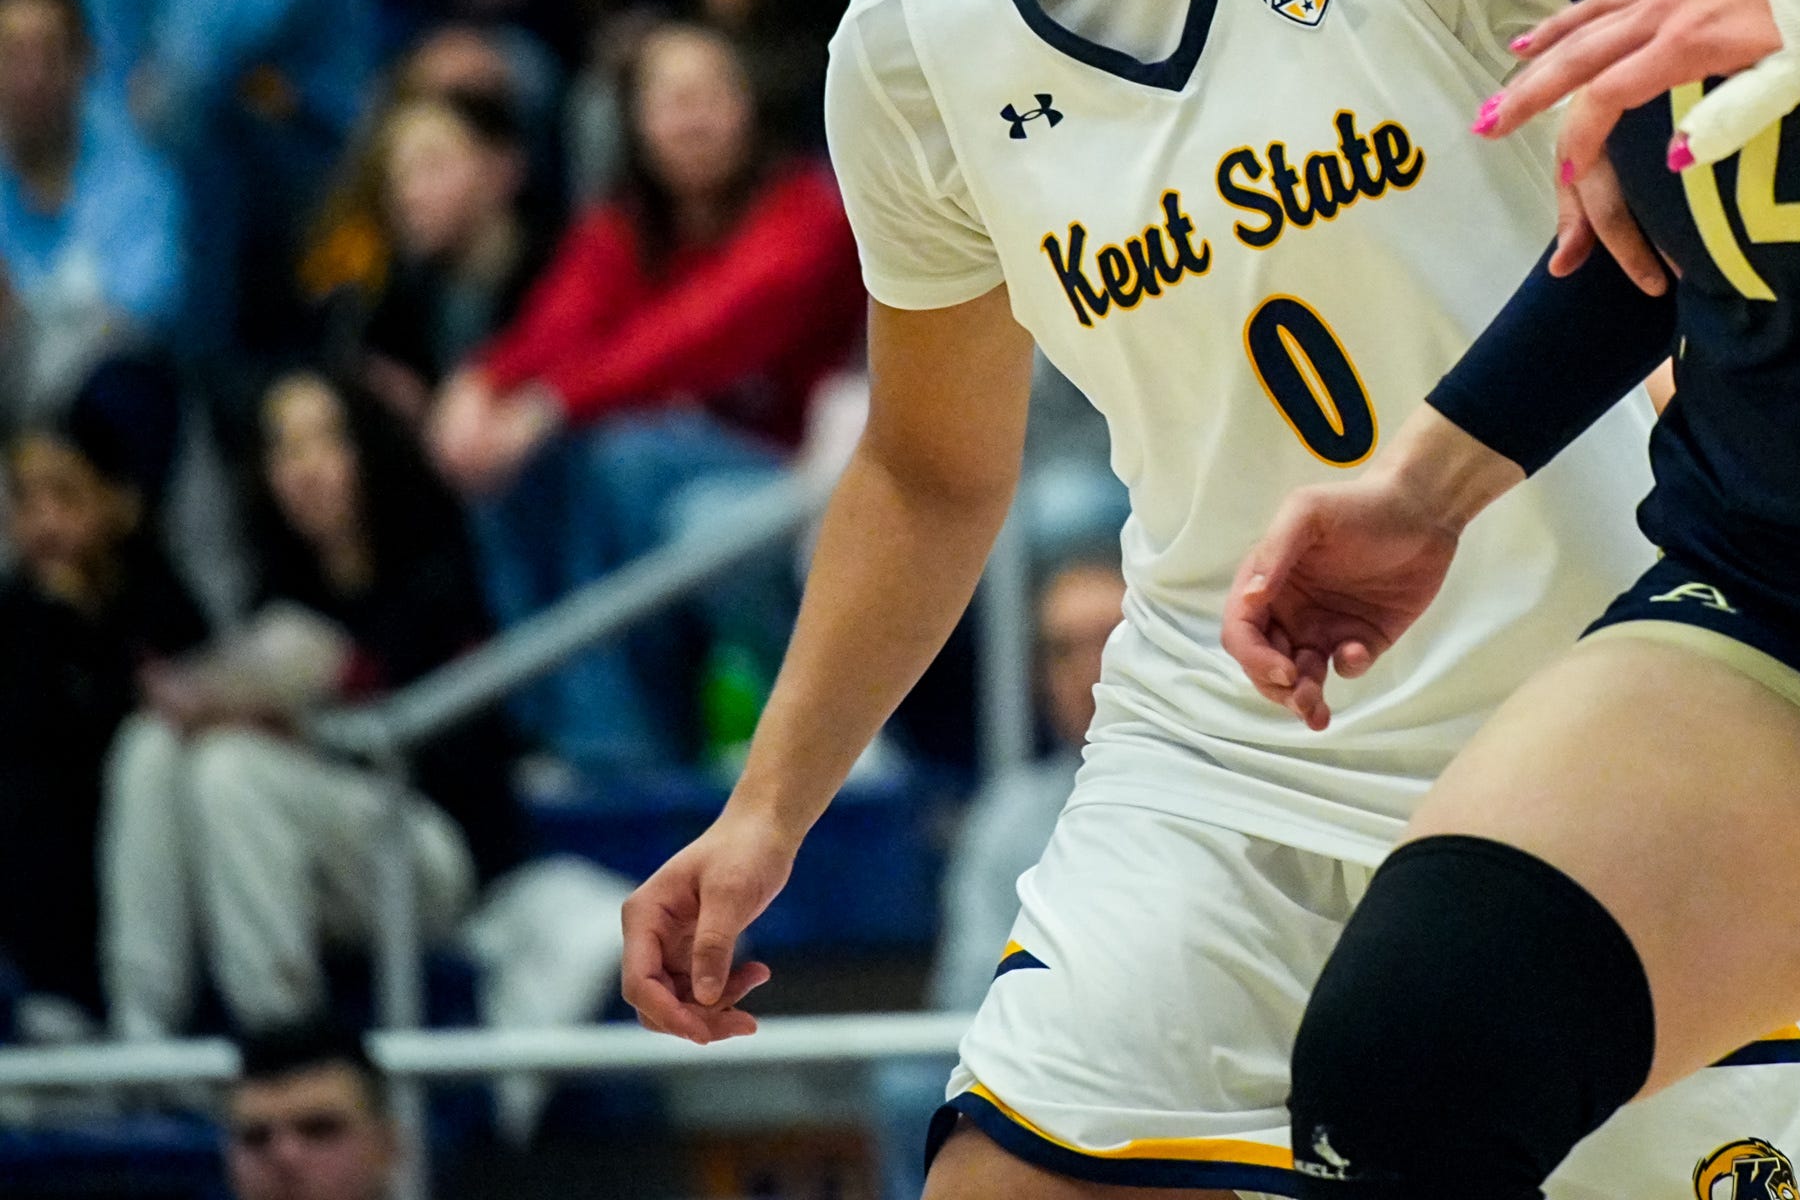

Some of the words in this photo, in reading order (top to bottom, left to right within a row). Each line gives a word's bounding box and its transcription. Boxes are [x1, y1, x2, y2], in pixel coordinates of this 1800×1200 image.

[1040, 188, 1211, 328] Kent
[1215, 108, 1426, 251] State
[1242, 292, 1379, 469] 0
